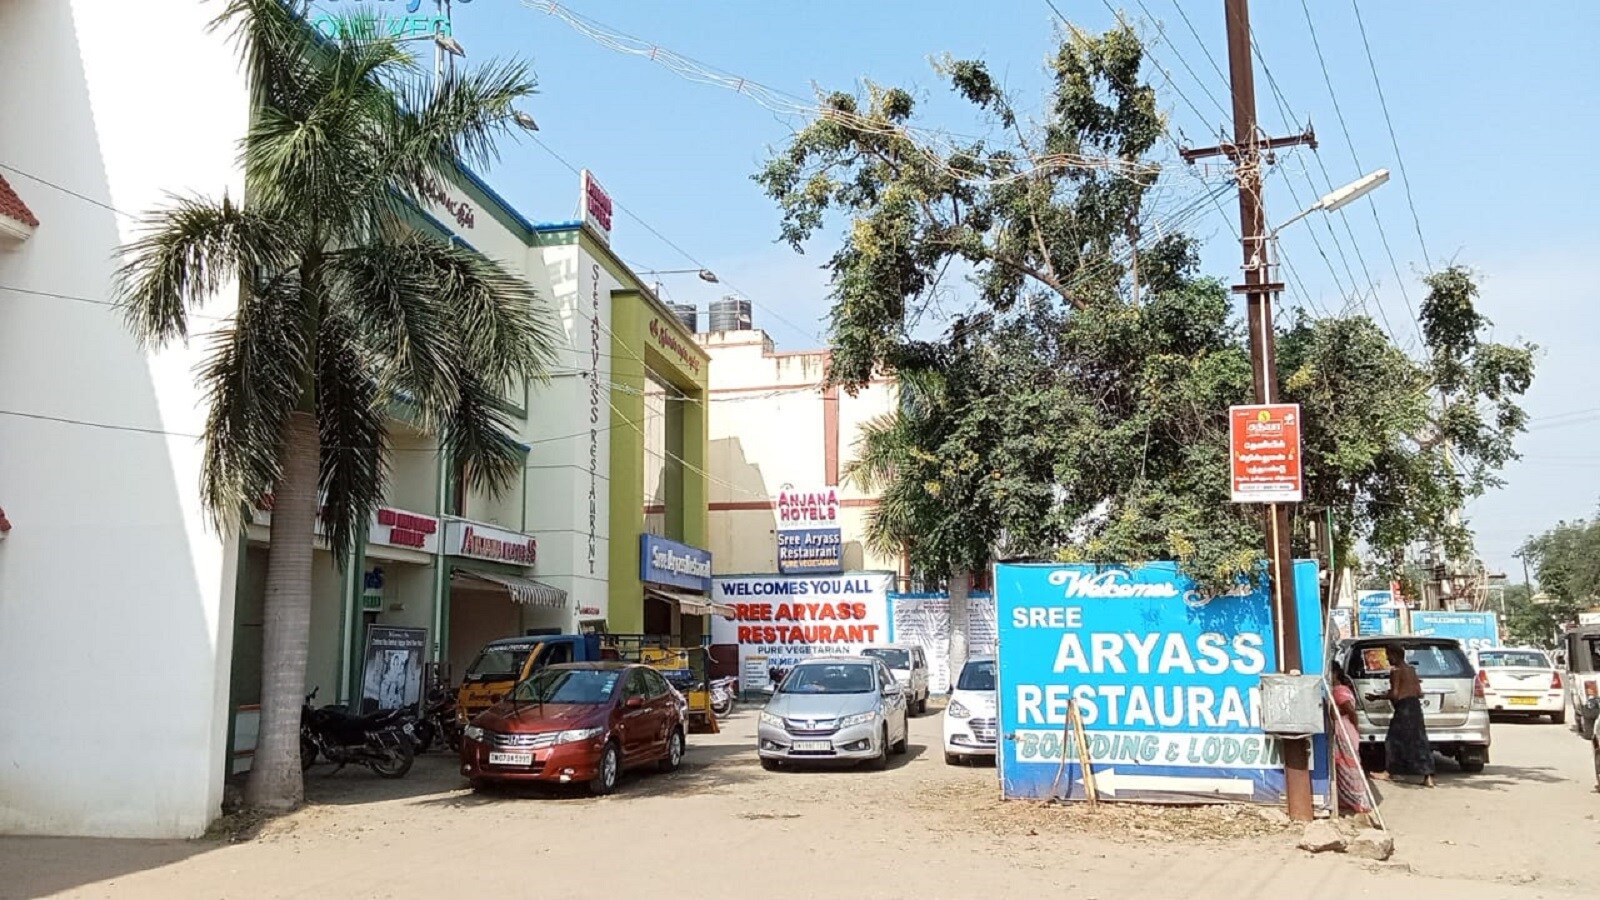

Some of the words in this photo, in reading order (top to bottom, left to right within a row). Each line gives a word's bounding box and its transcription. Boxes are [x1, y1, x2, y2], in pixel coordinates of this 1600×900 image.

[779, 489, 839, 507] ANJANA
[780, 507, 836, 521] HOTELS
[778, 534, 801, 546] Sree
[804, 533, 841, 548] Aryass
[780, 545, 839, 560] Restaurant
[722, 581, 808, 595] WELCOMES
[810, 580, 841, 594] YOU
[843, 579, 873, 593] ALL
[774, 601, 867, 621] ARYASS
[1012, 607, 1083, 628] SREE
[737, 624, 879, 644] RESTAURANT
[758, 646, 783, 655] PURE
[785, 645, 850, 655] VEGETARIAN
[1053, 632, 1267, 675] ARYASS
[1016, 684, 1262, 728] RESTAURA
